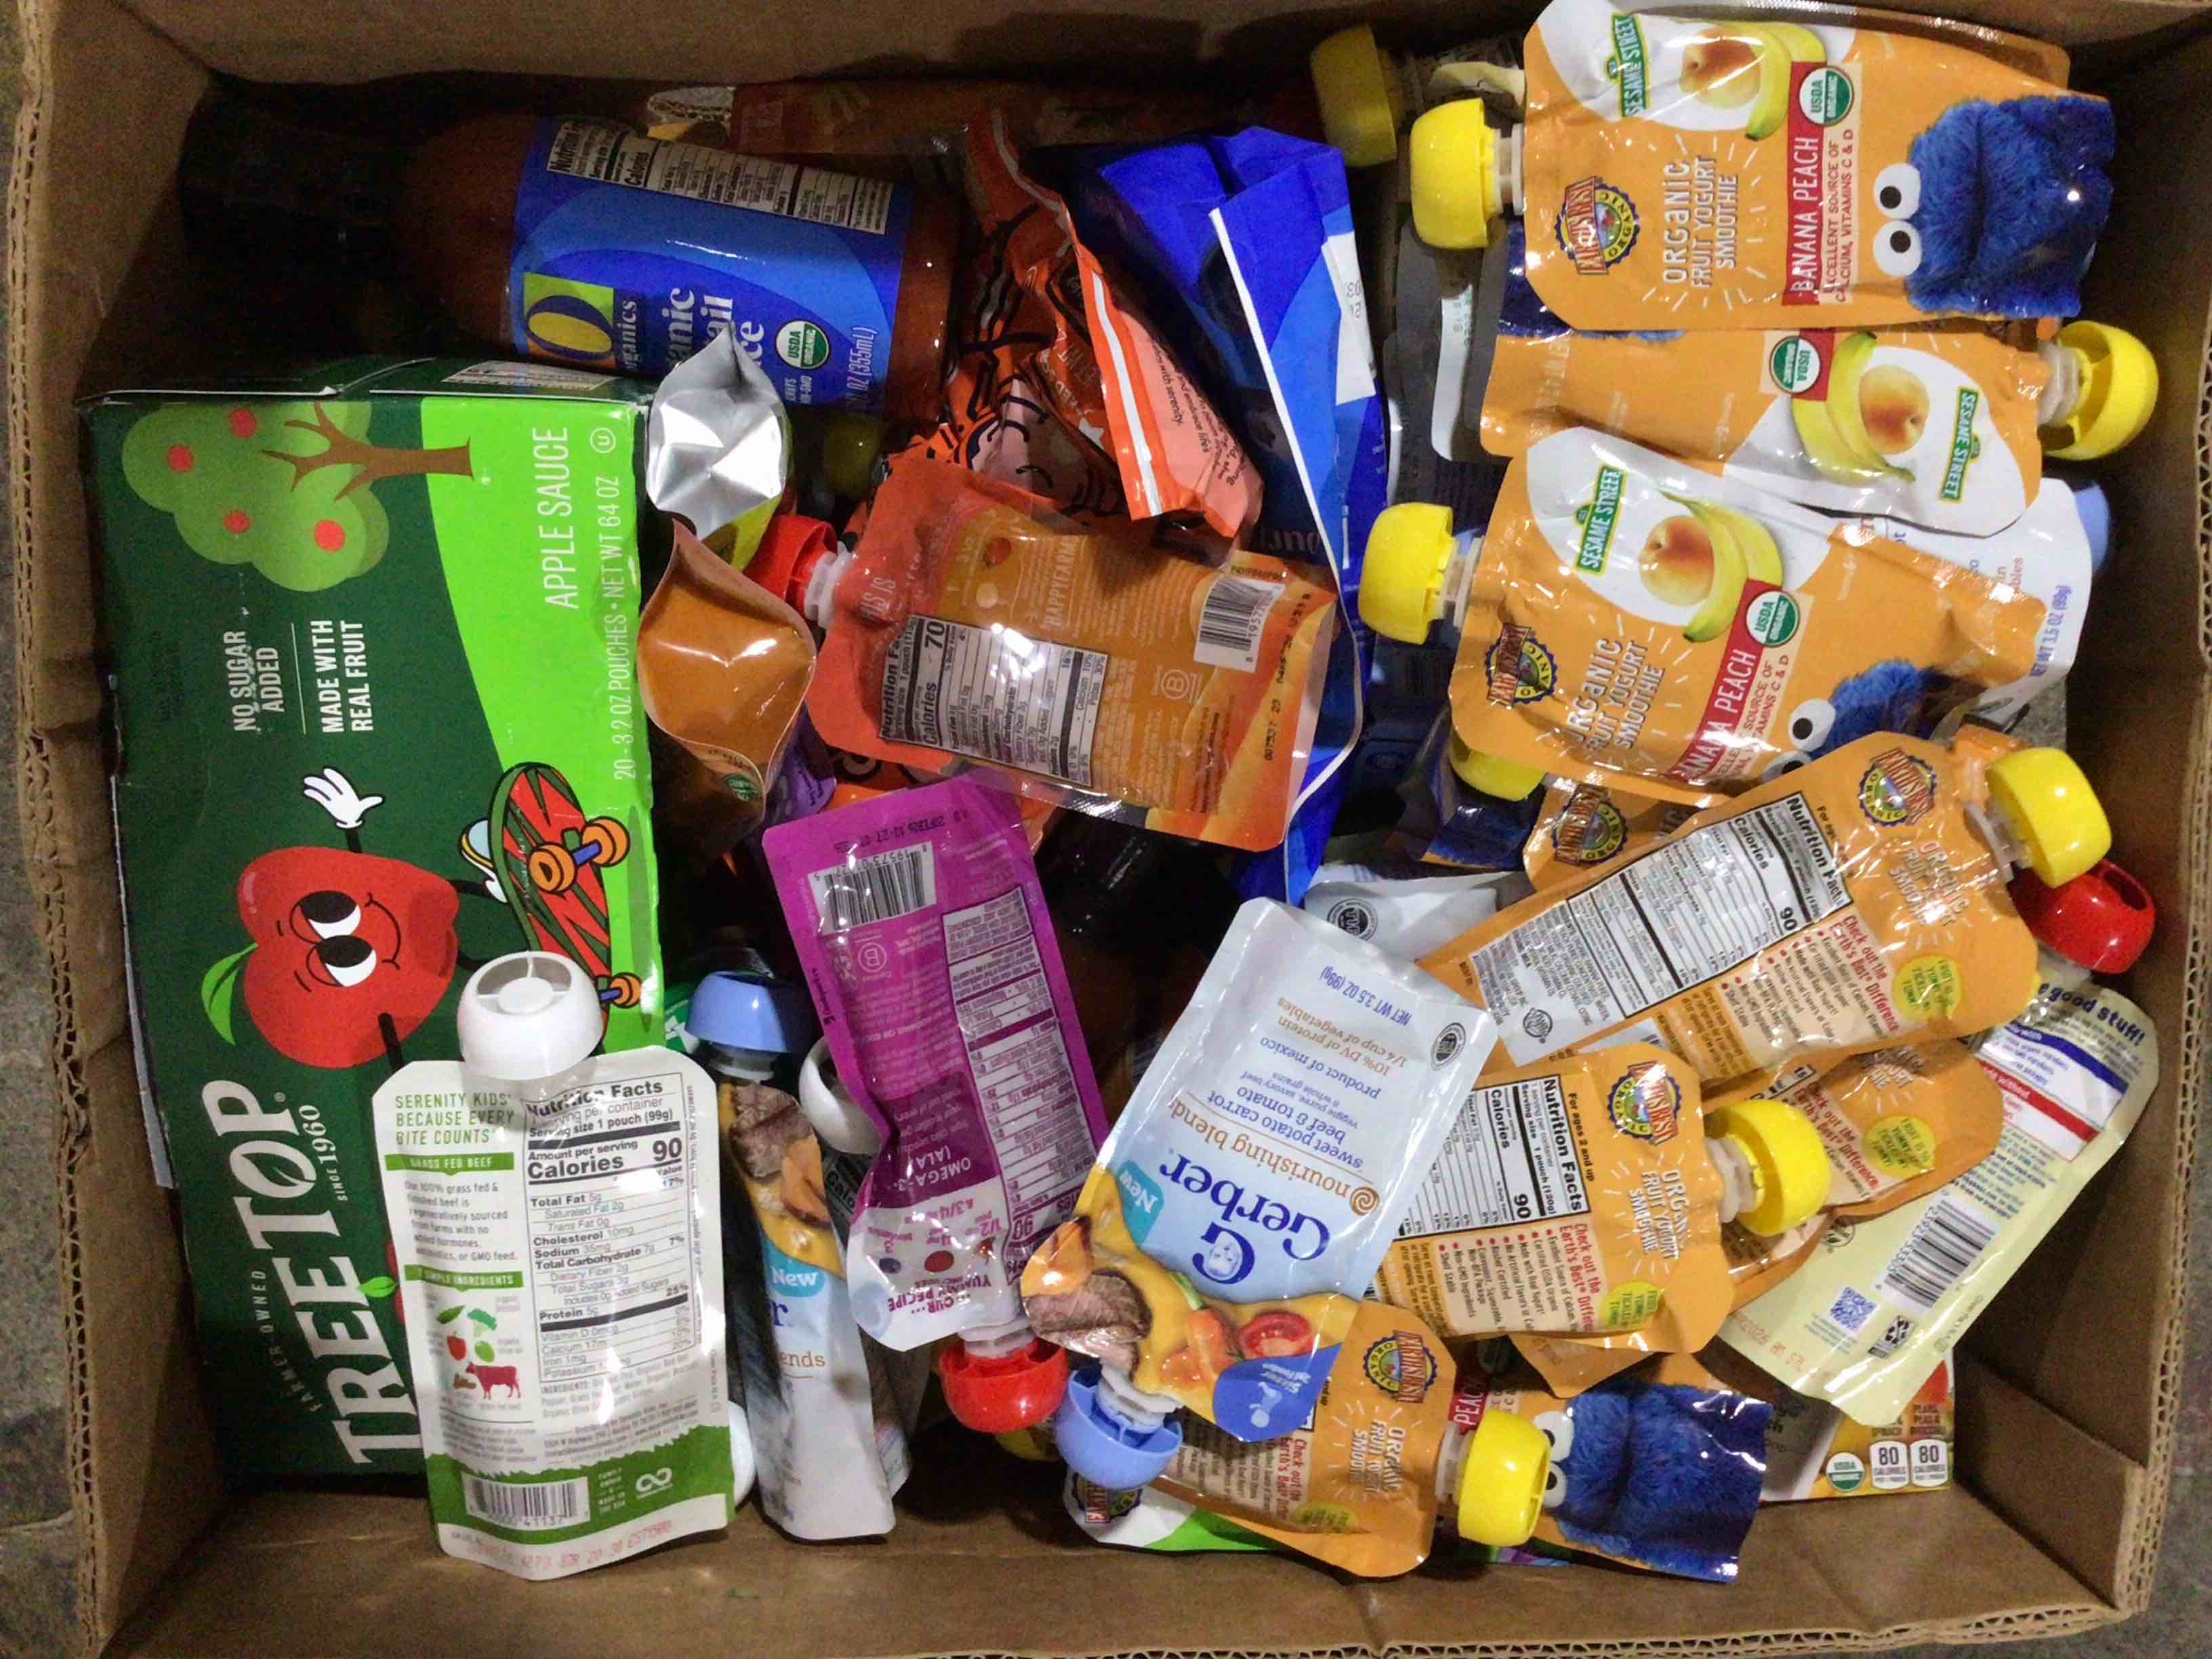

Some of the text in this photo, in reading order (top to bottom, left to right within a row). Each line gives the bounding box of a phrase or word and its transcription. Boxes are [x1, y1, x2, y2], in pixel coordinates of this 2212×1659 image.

[1616, 16, 1641, 115] SESAME STREET
[1809, 79, 1824, 113] USDA
[1841, 129, 1853, 236] VITAMINS C & D
[1692, 155, 1715, 287] FRUIT YOGURT
[1717, 174, 1738, 268] SMOOTHIE
[1792, 136, 1819, 292] BANANA PEACH
[1822, 140, 1839, 291] EXCELLENT SOURCE OF
[787, 325, 877, 376] USDA (355mL)
[1796, 350, 1810, 381] USDA
[1944, 392, 1974, 497] SESAME STREET
[531, 426, 581, 611] APPLE SAUCE
[1580, 466, 1622, 569] SESAME STREET
[595, 475, 636, 779] 20 OZ POUCHES NET WT 64 OZ
[1753, 598, 1776, 633] USDA
[223, 630, 256, 731] NO SUGAR
[255, 647, 285, 712] ADDED
[310, 619, 344, 732] MADE WITH
[340, 619, 373, 731] REAL FRUIT
[878, 621, 945, 744] Nutrition Calories 70
[1605, 638, 1650, 710] YOGURT
[1711, 646, 1759, 715] PEACH
[1741, 659, 1776, 731] SOURCE OF
[1614, 660, 1666, 752] SMOOTHIE
[1784, 796, 1830, 869] Nutrition
[1734, 814, 1800, 933] Calories 90
[1841, 914, 1889, 981] Check out the
[1317, 963, 1412, 1027] NET WT OZ (99g)
[2046, 985, 2098, 1015] good
[1274, 996, 1408, 1067] 1/4 cup of vegetables
[1275, 1015, 1391, 1077] 10% DV of protein
[611, 1080, 663, 1098] Facts
[1238, 1068, 1263, 1087] beef
[1257, 1035, 1381, 1101] product of mexico
[1270, 1069, 1332, 1105] whole grains
[395, 1090, 466, 1111] SERENITY
[396, 1107, 515, 1130] BECAUSE EVERY
[573, 1107, 673, 1134] size pouch (99g)
[607, 1097, 663, 1112] container
[1206, 1089, 1365, 1171] sweet potato carrot
[1235, 1084, 1347, 1145] beef & tomato
[1567, 1092, 1580, 1110] For
[1571, 1112, 1585, 1136] ages
[298, 1100, 341, 1168] 1960
[396, 1129, 428, 1146] BITE
[467, 1156, 493, 1168] BEEF
[527, 1136, 683, 1179] Calories 90
[528, 1140, 638, 1162] Amount per serving
[1490, 1089, 1530, 1220] Calories 90
[1520, 1084, 1557, 1215] Serving size pouch (120g)
[1542, 1079, 1584, 1211] Nutrition Facts
[1580, 1148, 1593, 1168] and
[447, 1182, 471, 1194] grass
[1118, 1168, 1158, 1213] New
[1227, 1129, 1351, 1207] nourishing
[1583, 1169, 1595, 1181] up
[1641, 1170, 1666, 1208] FRUIT
[470, 1210, 508, 1220] sourced
[531, 1194, 586, 1208] Total Fat
[545, 1206, 591, 1219] Saturated
[548, 1221, 576, 1231] Trans
[1149, 1147, 1335, 1269] Gerber
[533, 1229, 603, 1247] Cholesterol
[534, 1246, 579, 1258] Sodium
[535, 1248, 641, 1270] Total Carbohydrate
[1559, 1225, 1579, 1263] Earth's
[1574, 1223, 1601, 1294] Check out the
[195, 1086, 428, 1465] TREE TOP
[773, 1263, 819, 1289] New
[1452, 1250, 1477, 1318] Non-GMO Ingredients
[1496, 1269, 1512, 1300] Certified
[539, 1307, 583, 1320] Protein
[1879, 1445, 1939, 1465] 80 80
